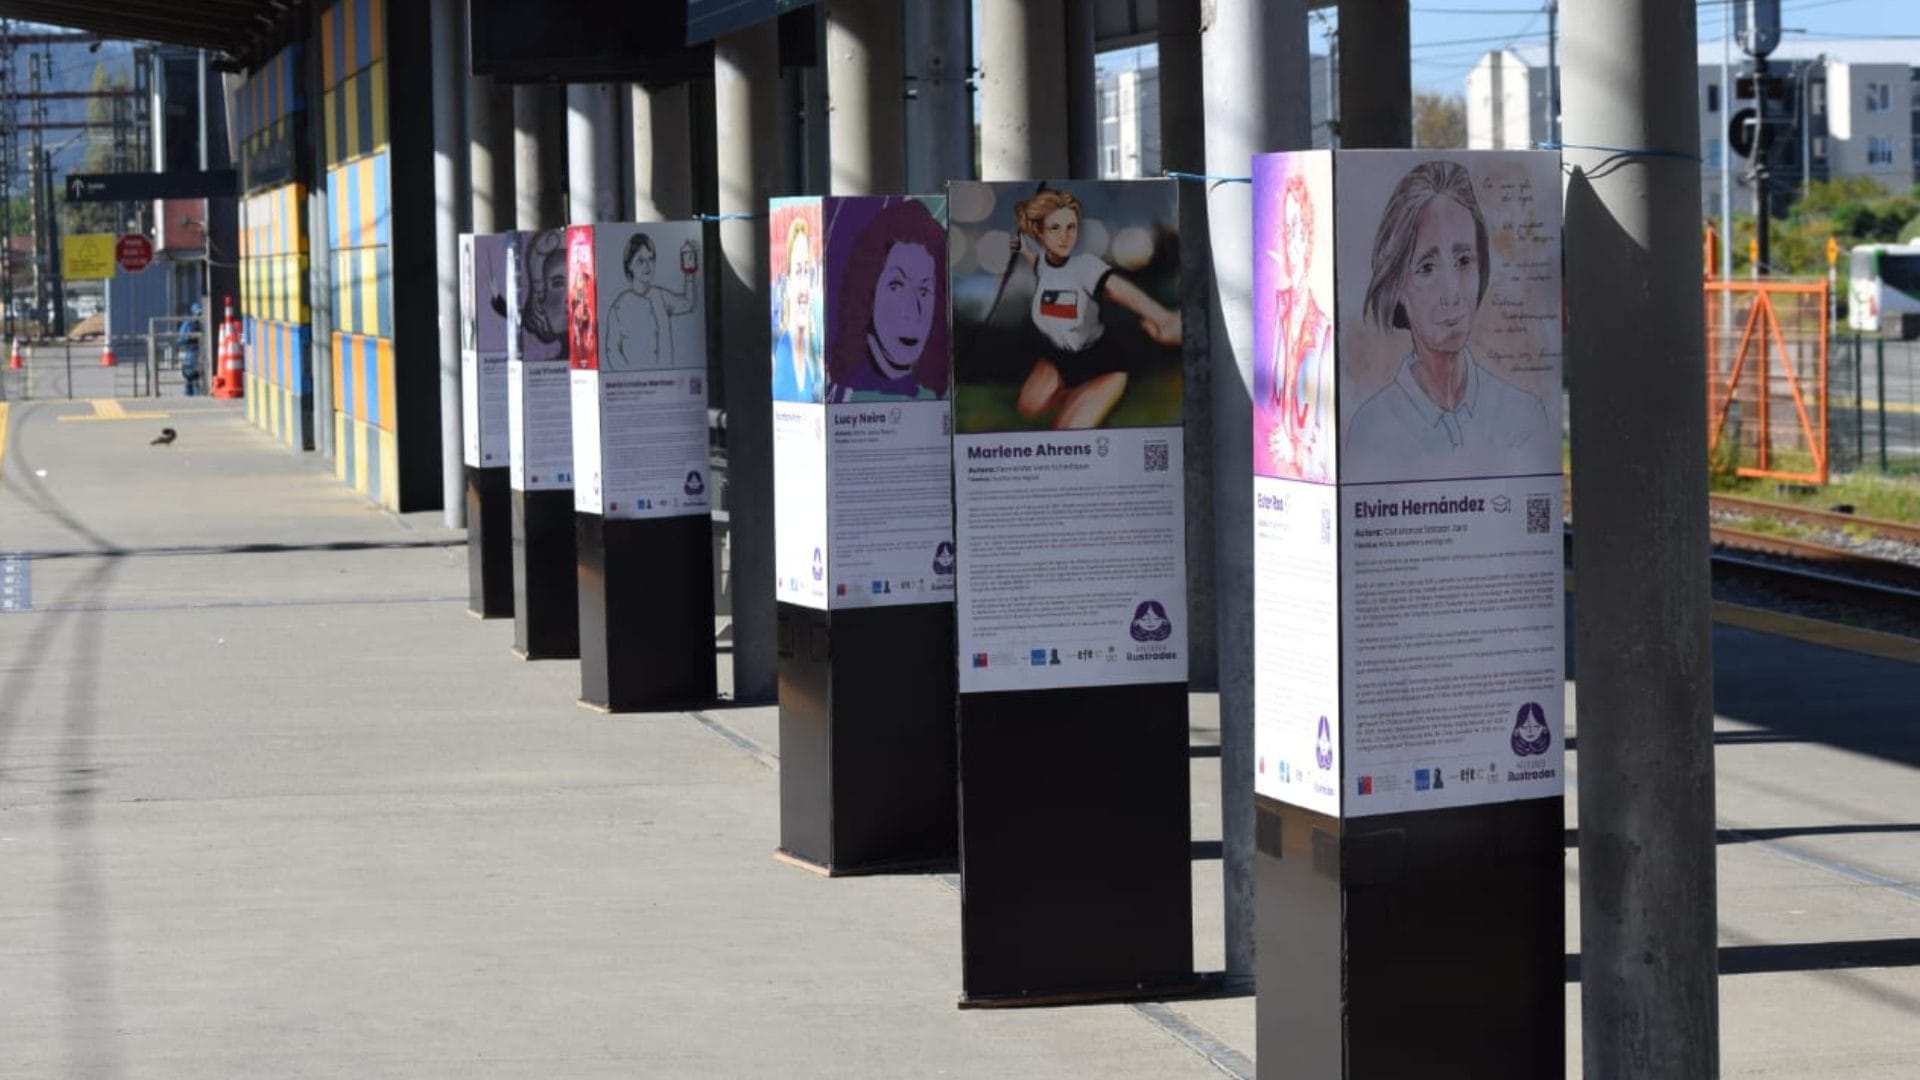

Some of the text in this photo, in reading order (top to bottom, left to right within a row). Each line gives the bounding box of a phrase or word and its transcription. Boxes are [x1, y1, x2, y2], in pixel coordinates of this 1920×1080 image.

[835, 411, 886, 428] Lucy Neira
[967, 443, 1092, 459] Marlene Ahrens
[1354, 495, 1485, 518] Elvira Hernández
[1126, 651, 1177, 661] ilustradas
[1507, 768, 1556, 782] ilustradas
